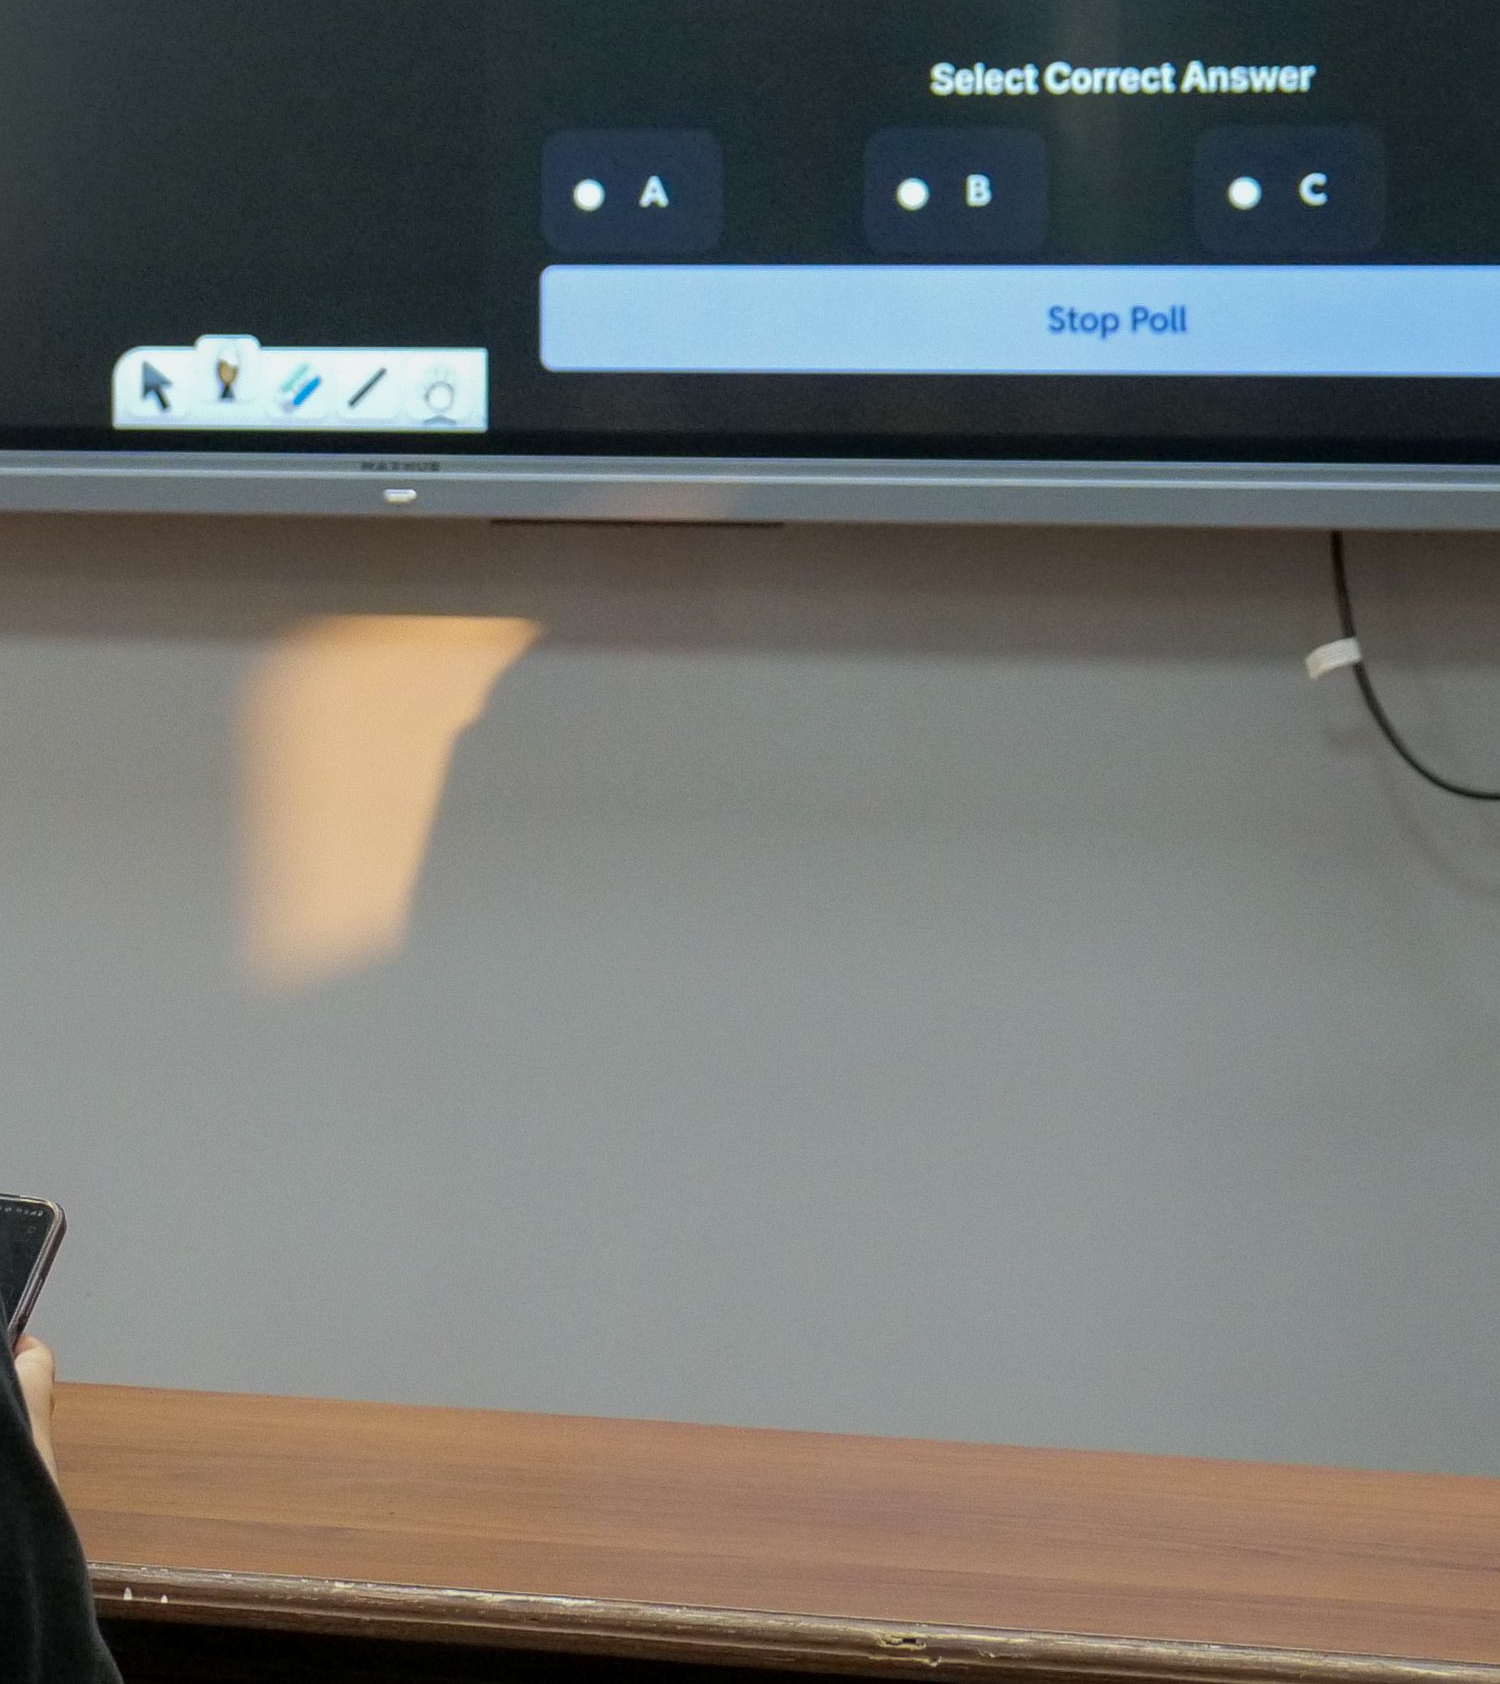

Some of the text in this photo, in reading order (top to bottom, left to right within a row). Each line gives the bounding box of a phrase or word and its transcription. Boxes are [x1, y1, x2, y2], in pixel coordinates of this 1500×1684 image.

[930, 60, 1316, 96] Select Correct Answer
[639, 175, 669, 208] A
[966, 174, 992, 207] B
[1298, 172, 1328, 206] C
[1048, 304, 1188, 340] Stop Poll
